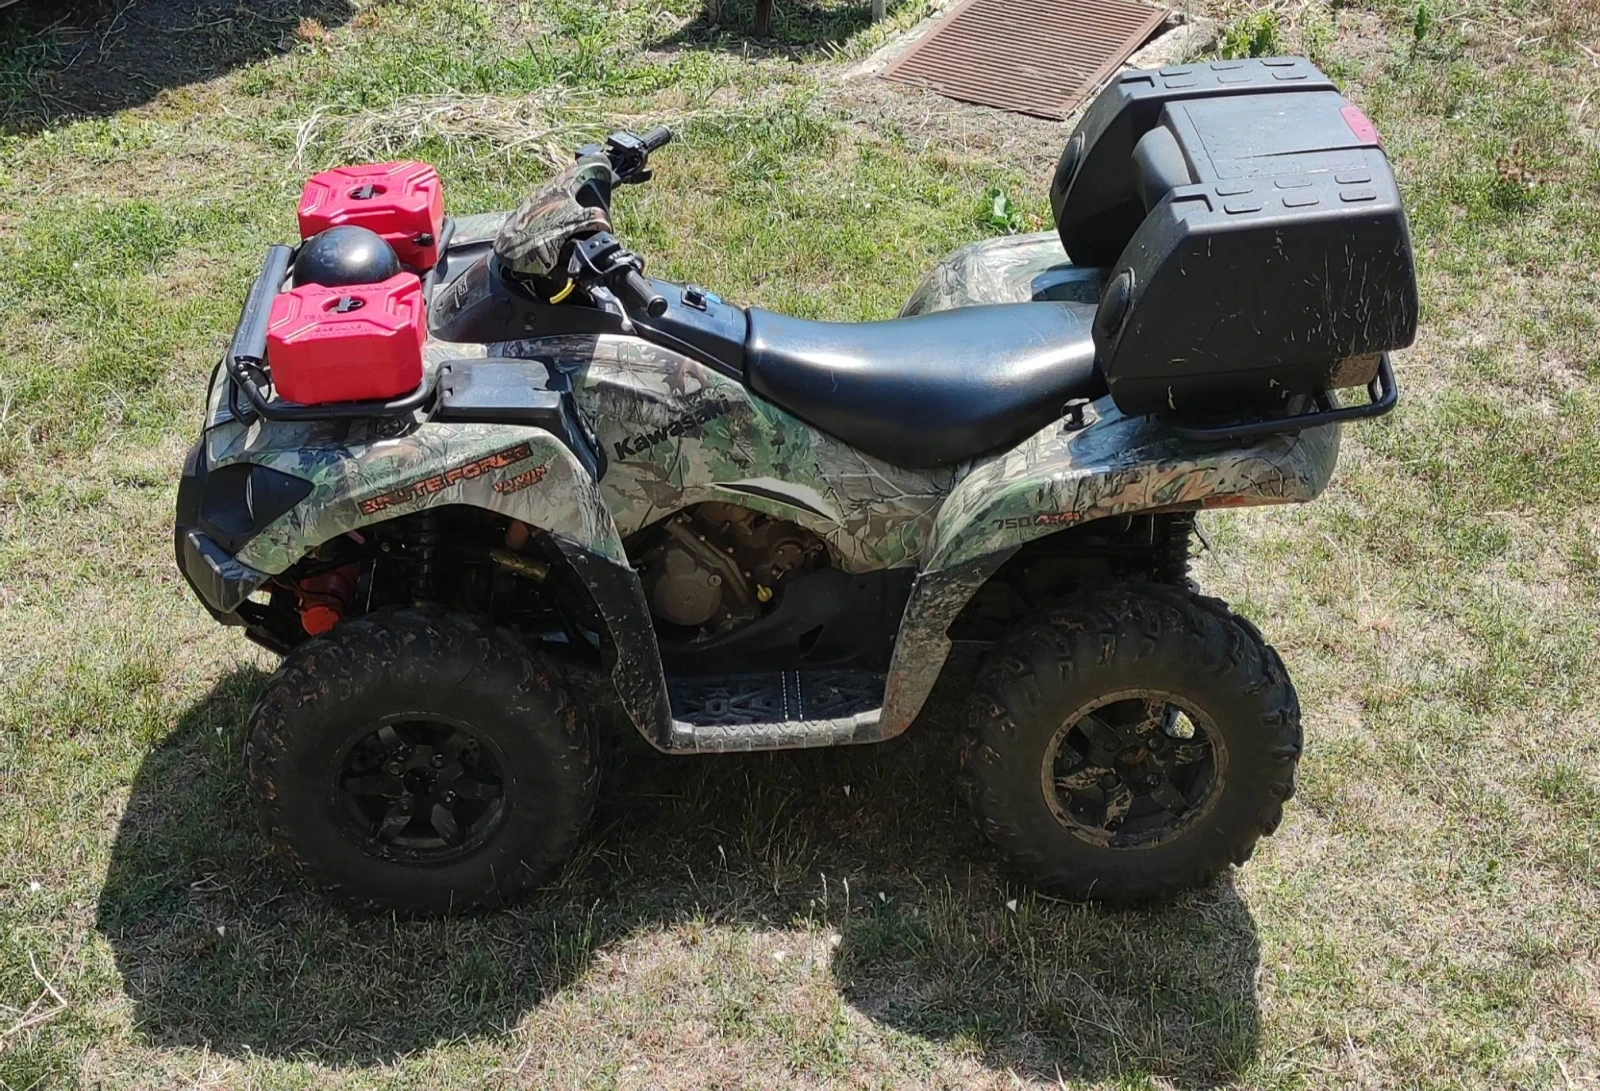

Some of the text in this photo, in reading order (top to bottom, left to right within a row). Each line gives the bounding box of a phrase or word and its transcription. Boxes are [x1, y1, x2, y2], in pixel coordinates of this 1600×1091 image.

[613, 394, 732, 461] Kawasaki
[357, 474, 447, 515] BRUTE
[991, 516, 1032, 531] 750
